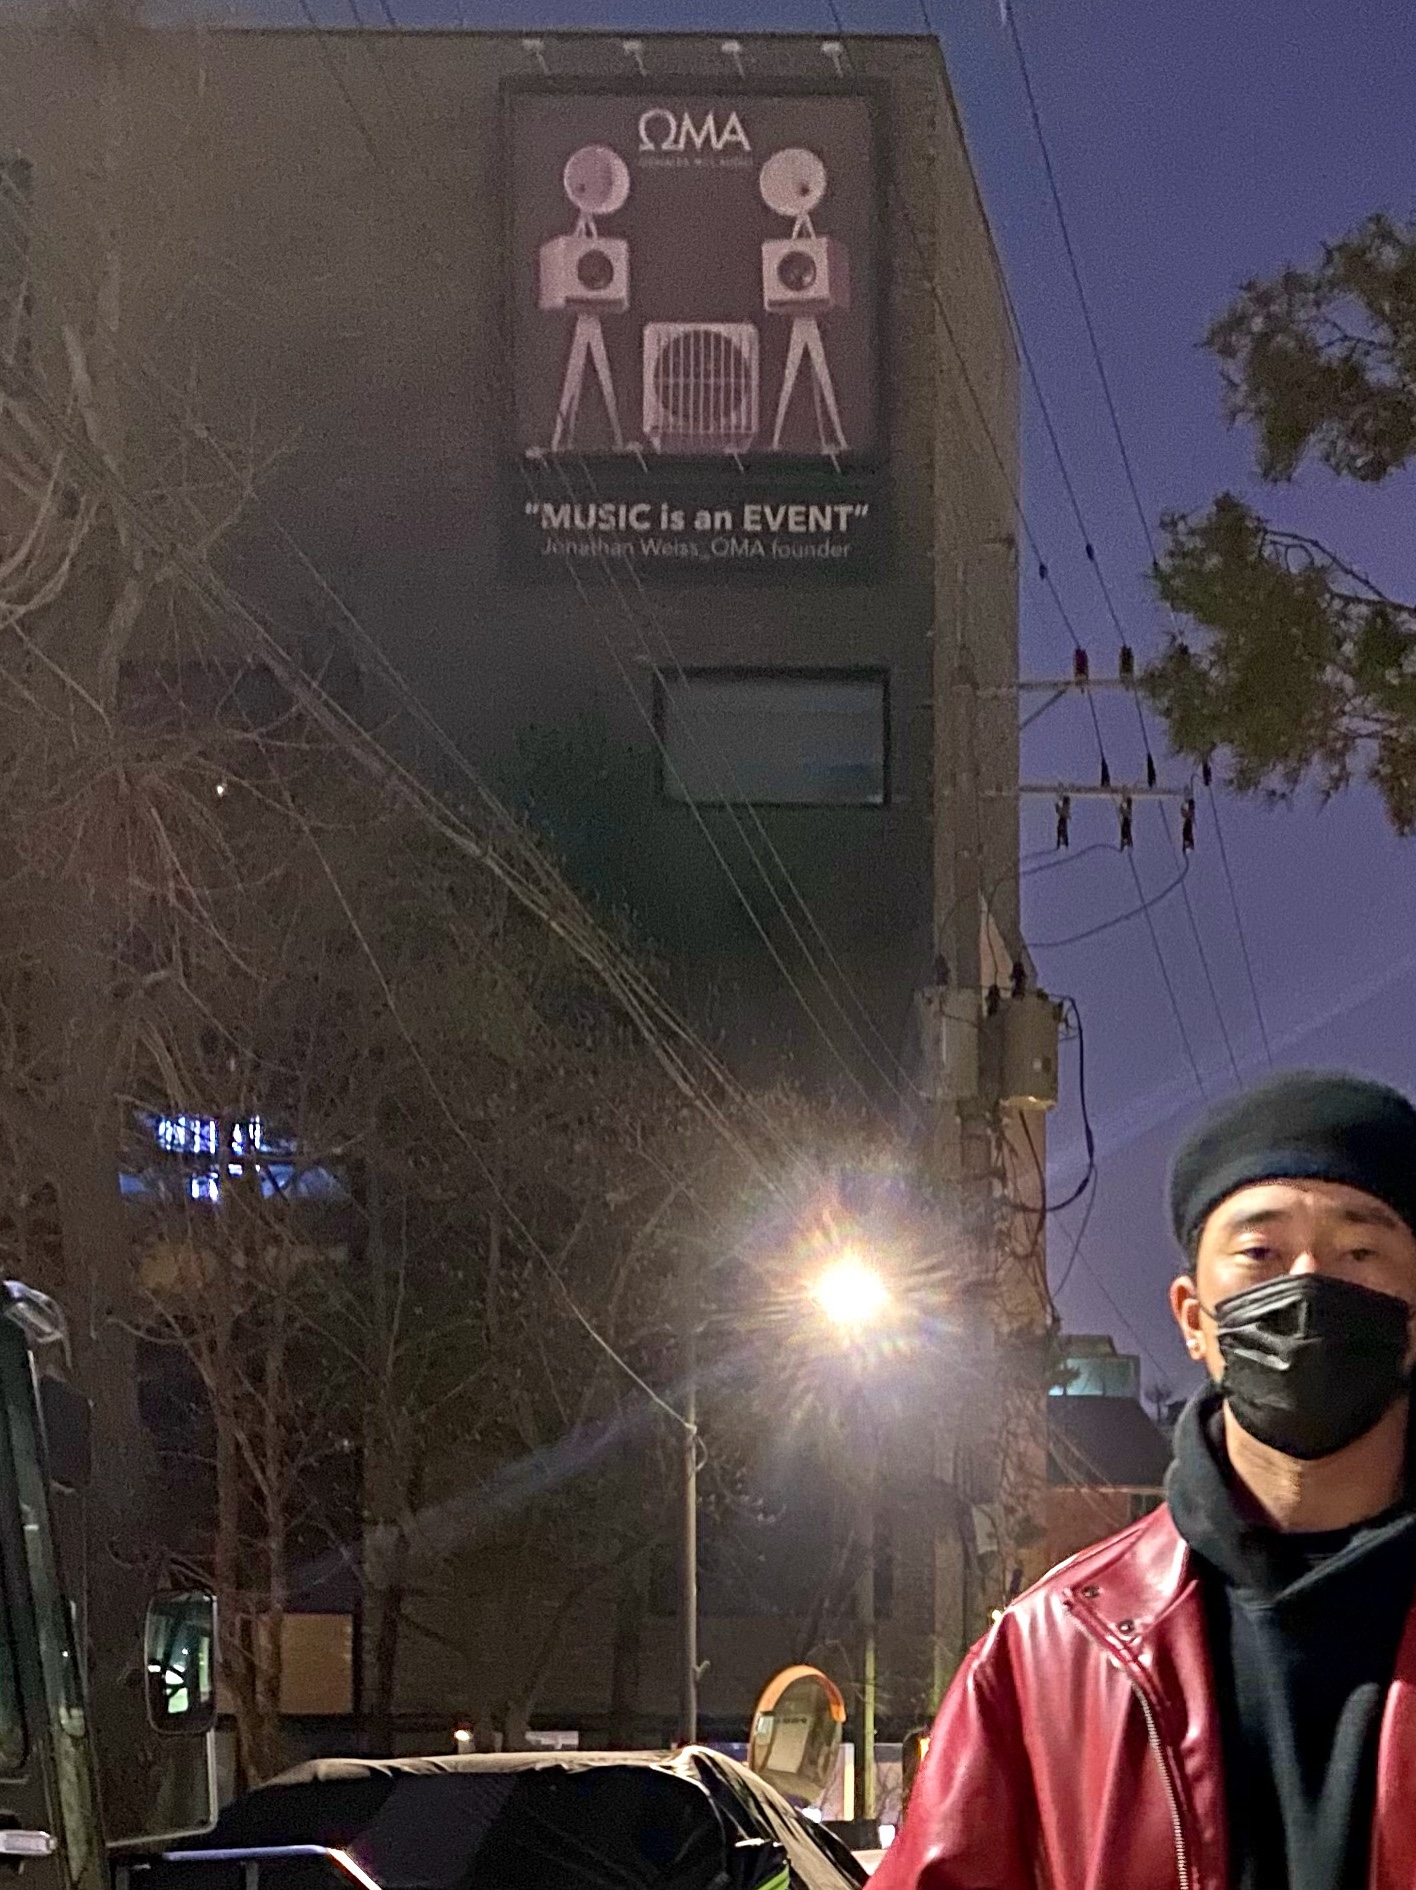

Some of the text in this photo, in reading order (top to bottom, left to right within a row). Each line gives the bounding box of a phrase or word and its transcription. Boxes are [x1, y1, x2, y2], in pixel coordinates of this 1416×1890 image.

[660, 502, 685, 531] is
[694, 510, 733, 531] an
[711, 537, 766, 558] OMA
[772, 537, 849, 559] founder
